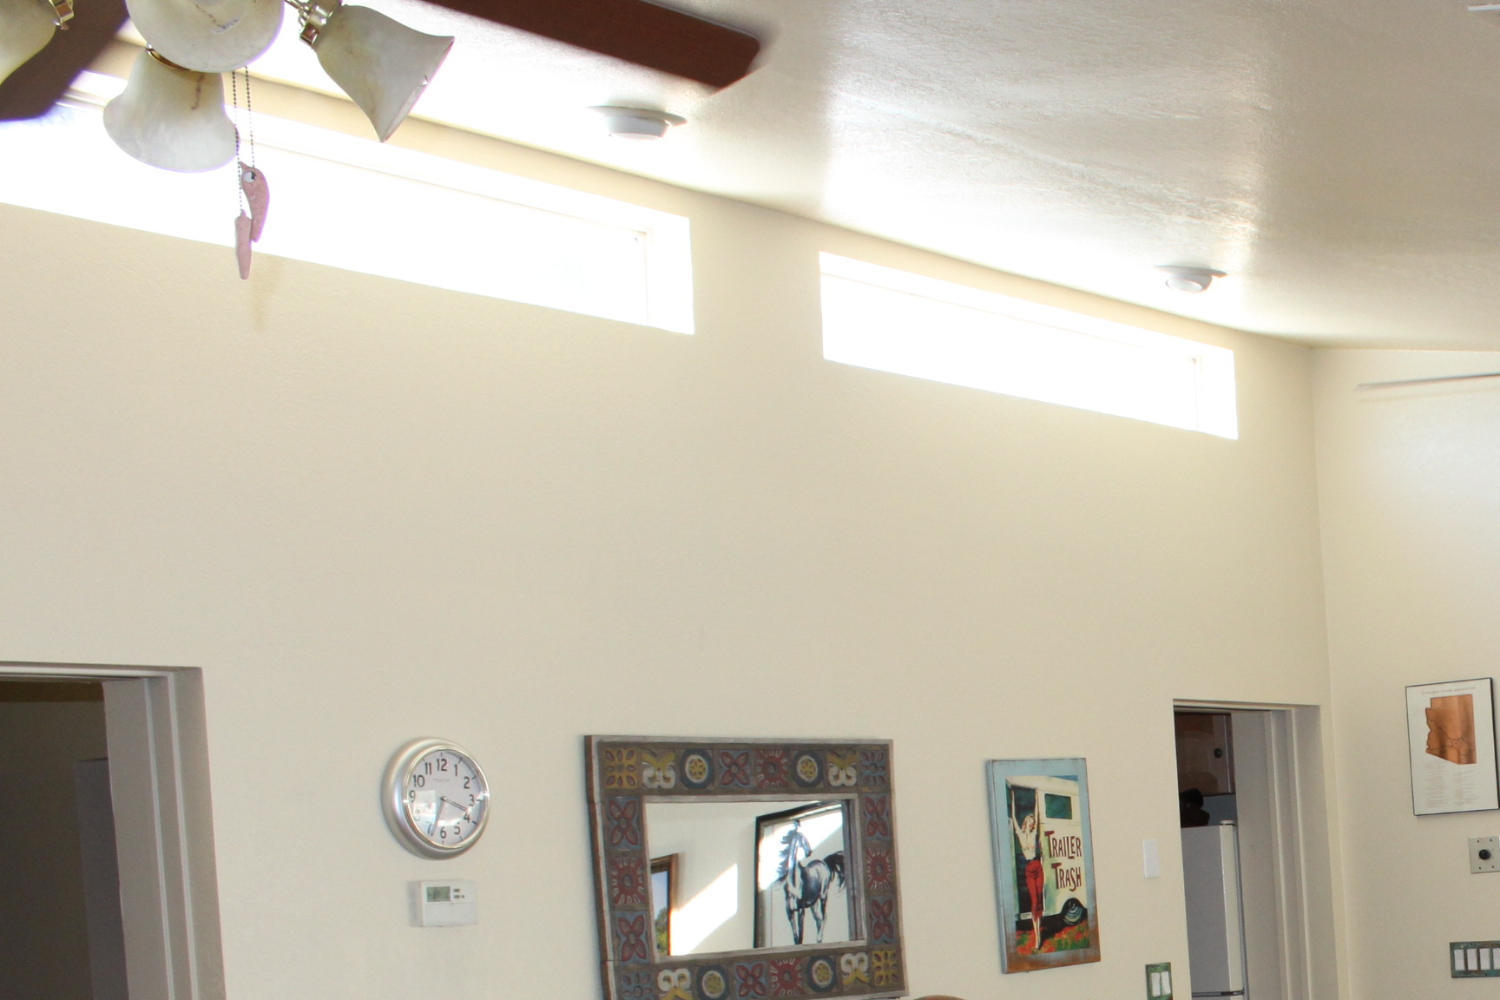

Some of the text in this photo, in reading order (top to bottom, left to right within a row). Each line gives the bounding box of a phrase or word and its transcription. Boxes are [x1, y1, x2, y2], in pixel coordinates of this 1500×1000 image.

[424, 762, 432, 775] 11
[436, 758, 448, 772] 12
[413, 774, 425, 788] 10
[463, 776, 470, 789] 2
[408, 790, 416, 803] 9
[468, 794, 475, 807] 3
[440, 826, 447, 839] 6
[1044, 830, 1082, 859] TRAILER
[1051, 862, 1082, 891] TRASH
